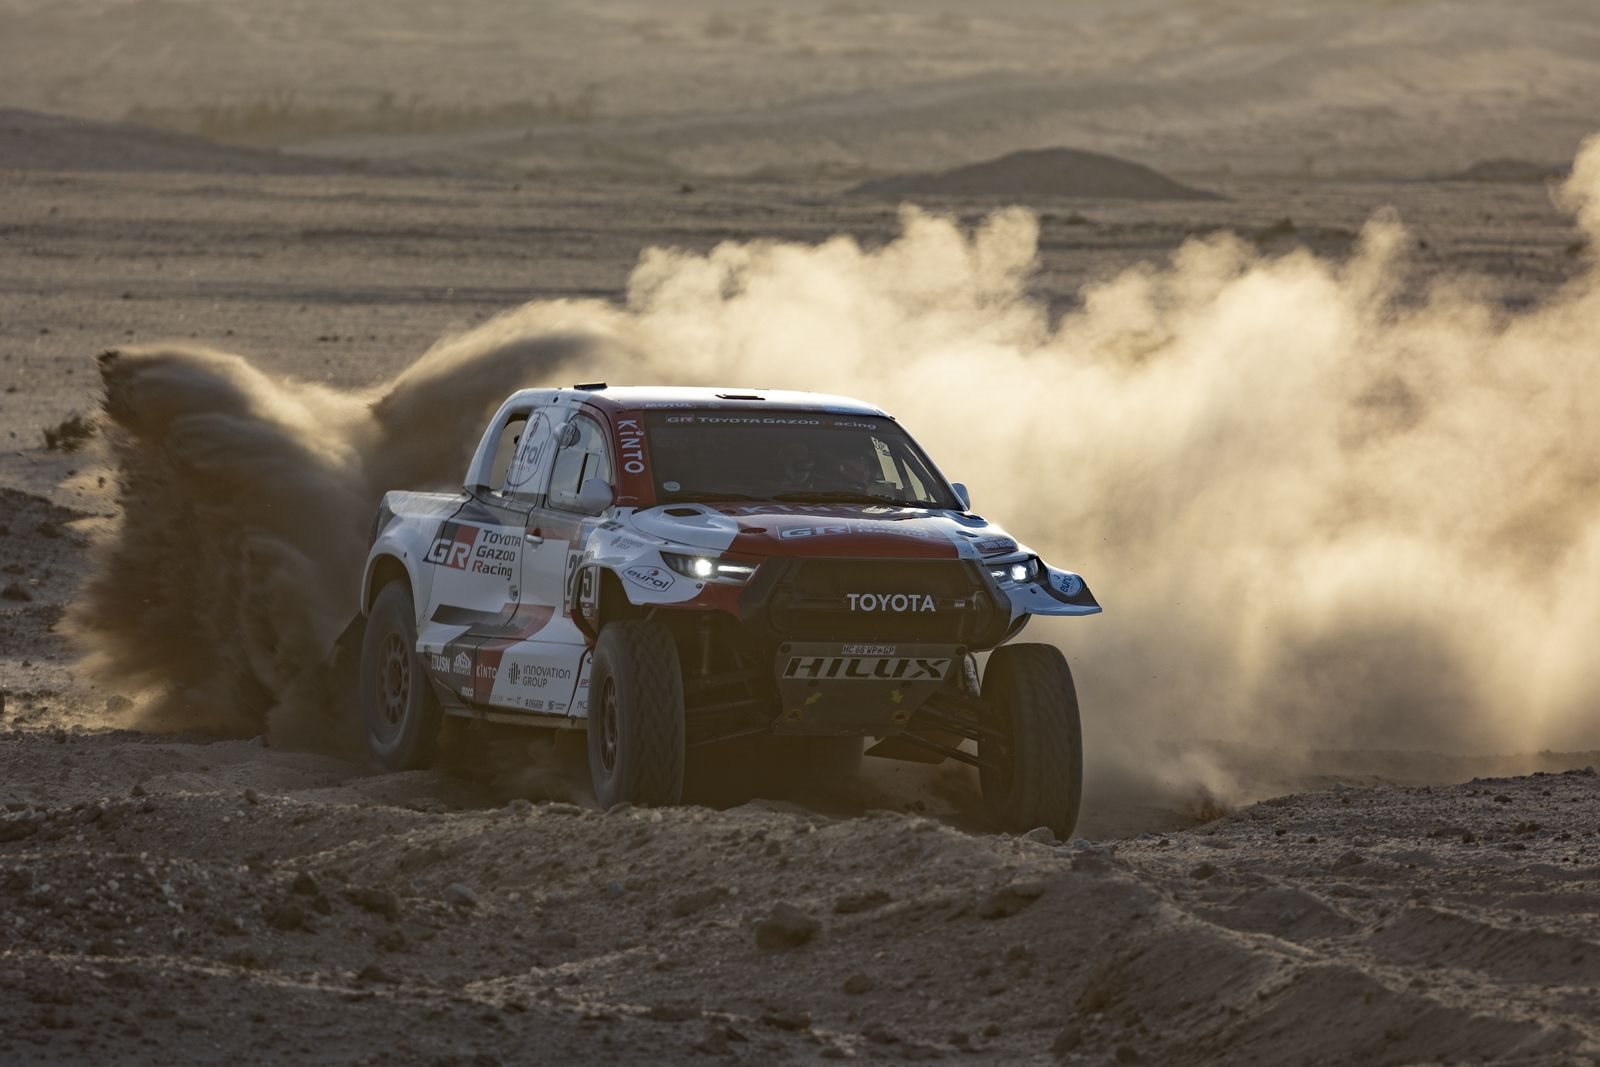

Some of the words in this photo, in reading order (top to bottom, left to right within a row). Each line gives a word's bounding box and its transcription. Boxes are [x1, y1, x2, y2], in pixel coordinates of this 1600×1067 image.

[825, 420, 877, 430] acing
[483, 529, 522, 547] TOYOTA
[427, 538, 471, 568] GR
[476, 545, 516, 562] GAZOO
[472, 560, 513, 581] Racing
[626, 570, 670, 590] eurol
[847, 593, 936, 612] TOYOTA
[523, 663, 571, 680] INNOVATION
[783, 657, 947, 679] HILUX
[523, 675, 548, 688] GROUP
